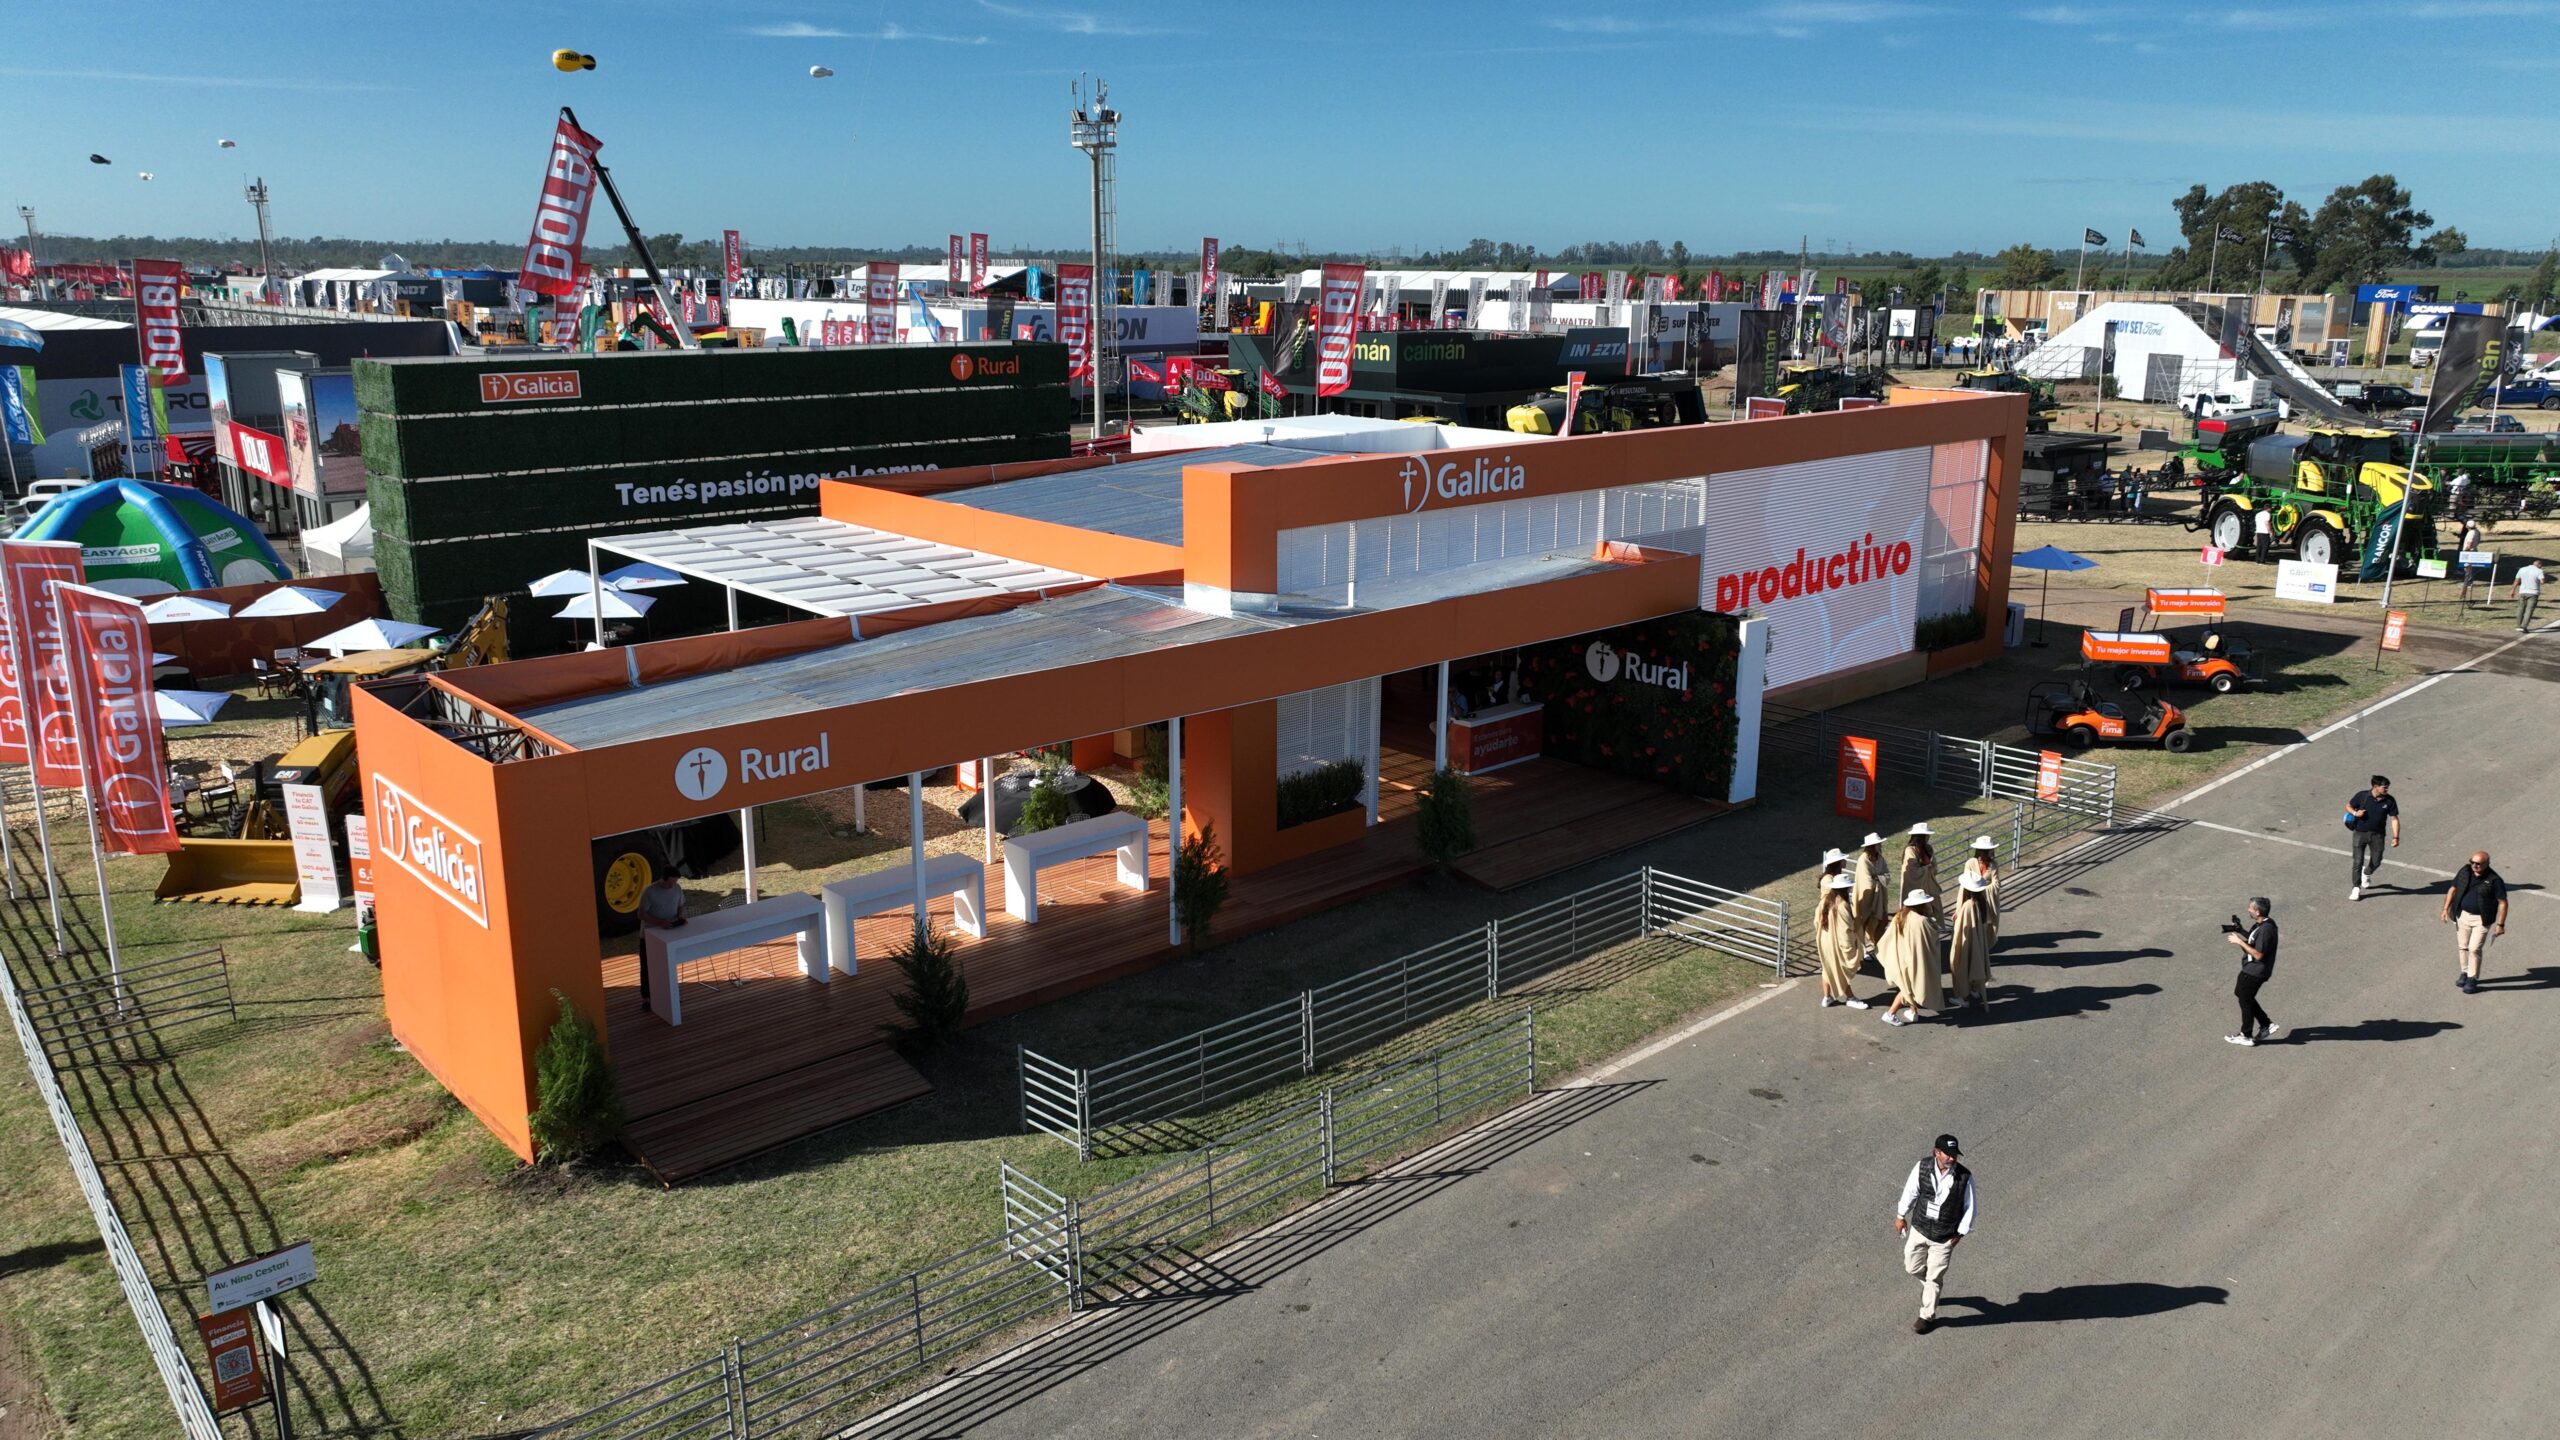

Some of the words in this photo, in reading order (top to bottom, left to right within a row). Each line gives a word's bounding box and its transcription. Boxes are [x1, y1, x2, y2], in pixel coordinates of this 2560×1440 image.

[2271, 227, 2294, 242] Ford
[976, 237, 985, 277] AKRON
[2374, 288, 2400, 300] Ford
[140, 273, 185, 375] DOLBI
[1061, 277, 1090, 367] DOLBI
[1319, 279, 1360, 384] DOLBI
[1780, 313, 1794, 341] Ford
[1852, 316, 1867, 345] Ford
[2130, 319, 2144, 335] SET
[2142, 321, 2165, 336] Ford
[2278, 307, 2292, 331] Ford
[977, 354, 1020, 375] Rural
[1352, 338, 1391, 362] mán
[1402, 338, 1465, 363] caimán
[1763, 329, 1777, 396] caimán
[2504, 339, 2522, 376] Ford
[513, 376, 574, 395] Galicia
[135, 368, 153, 438] EASYAGRO
[239, 431, 273, 477] DOLBI
[615, 477, 698, 507] Tenés
[701, 470, 786, 504] pasión
[1436, 455, 1525, 499] Galicia
[81, 547, 157, 557] EASYAGRO
[2371, 523, 2392, 565] BANCOR
[1715, 532, 1912, 613] productivo
[2159, 599, 2169, 607] Tu
[2168, 600, 2189, 608] mejor
[2190, 599, 2222, 607] inversión
[2107, 647, 2130, 656] mejor
[2130, 647, 2165, 656] inversión
[1625, 651, 1689, 691] Rural
[2187, 669, 2206, 677] Fima
[99, 629, 143, 764] Galicia
[2101, 726, 2123, 734] Fima
[740, 732, 830, 784] Rural
[1473, 735, 1519, 757] ayudarte
[274, 770, 298, 779] CAT
[408, 815, 480, 904] Galicia
[214, 1281, 229, 1291] Av.
[230, 1273, 253, 1286] Nino
[255, 1259, 290, 1278] Cestari
[222, 1330, 246, 1342] Galicia
